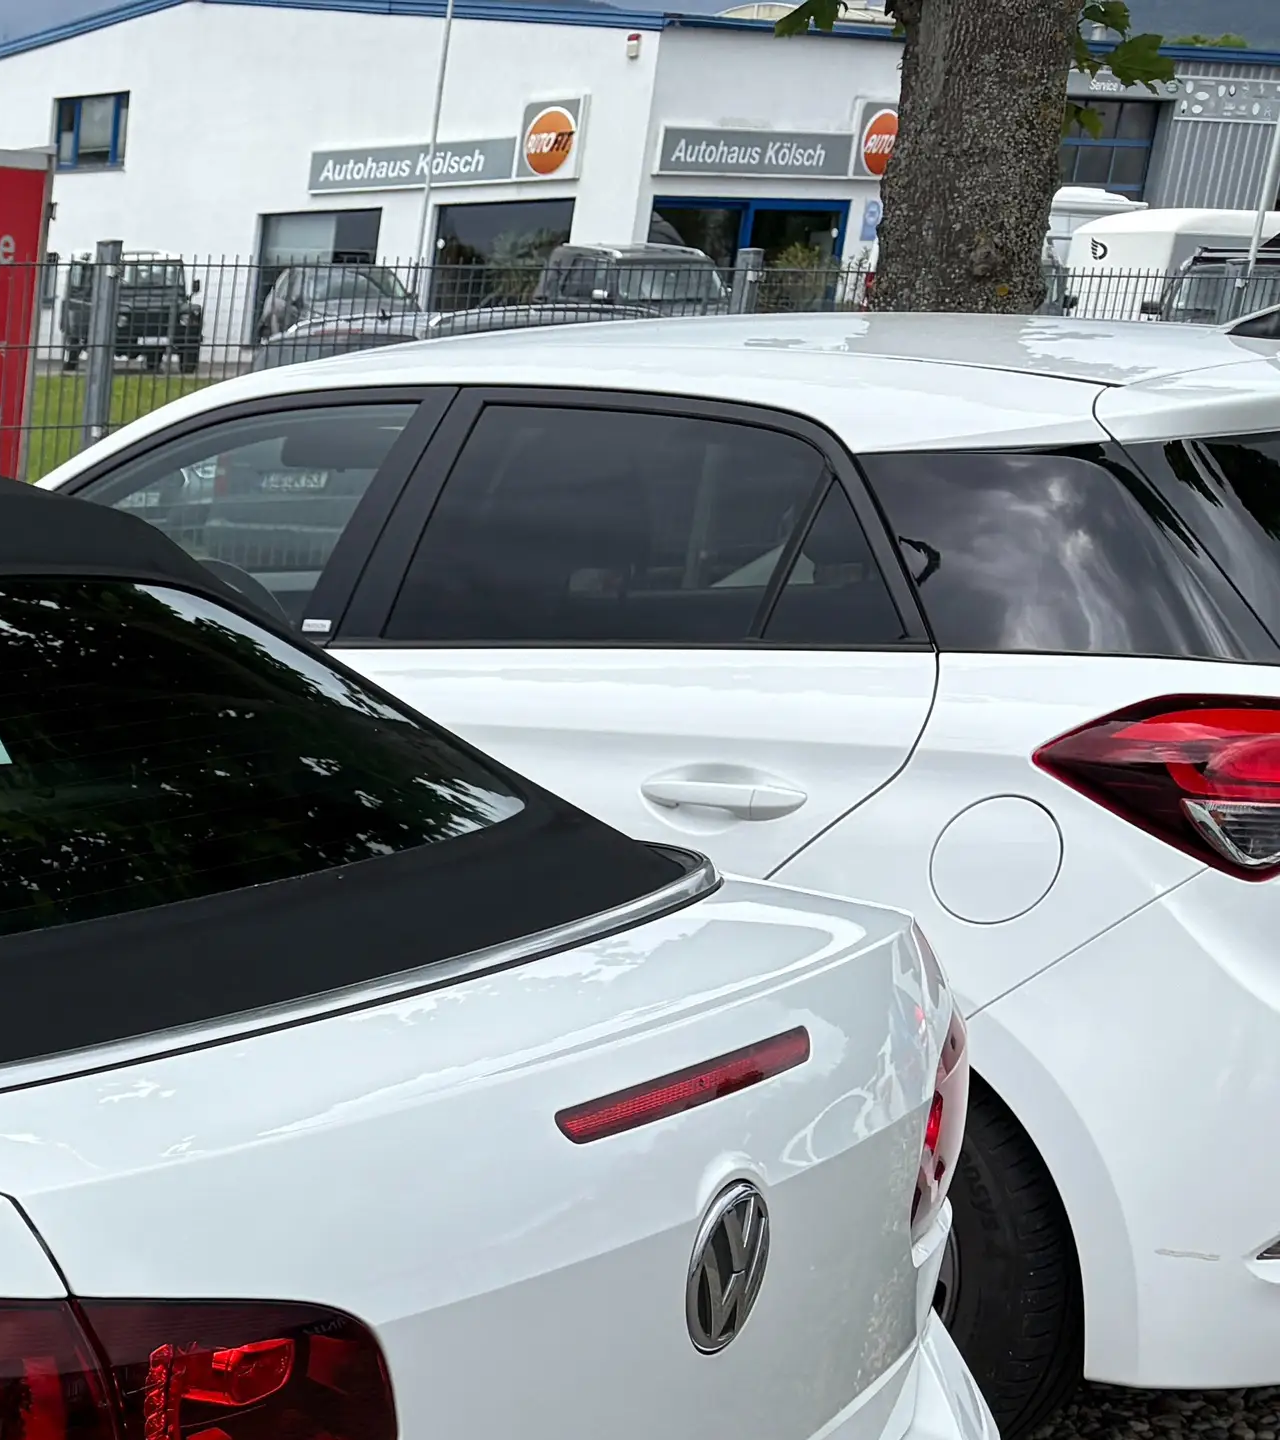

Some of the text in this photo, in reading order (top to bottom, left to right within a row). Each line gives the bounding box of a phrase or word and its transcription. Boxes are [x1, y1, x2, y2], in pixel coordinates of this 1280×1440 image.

[671, 138, 826, 168] Autohaus Kölsch
[865, 133, 897, 154] AUTO
[319, 149, 485, 182] Autohaus Kölsch
